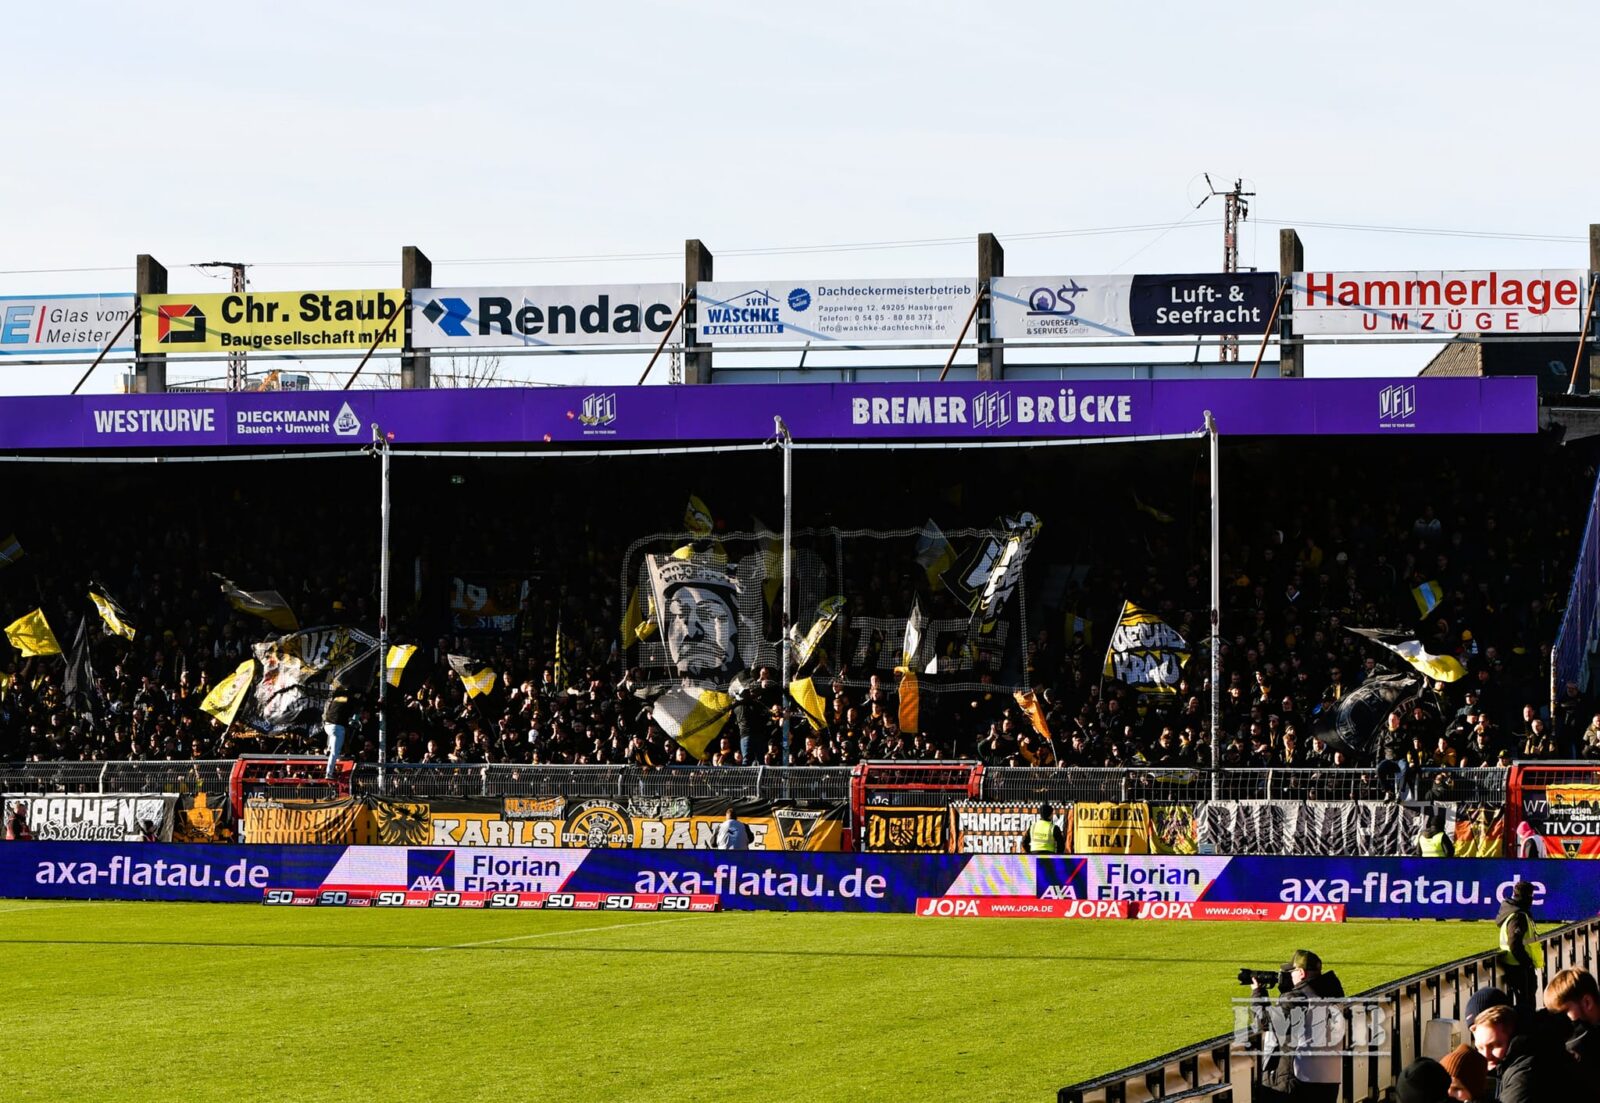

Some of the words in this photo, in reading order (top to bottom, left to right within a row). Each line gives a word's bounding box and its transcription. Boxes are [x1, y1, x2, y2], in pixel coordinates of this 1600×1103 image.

[817, 285, 971, 297] Dachdeckermeisterbetrieb
[1171, 285, 1222, 303] Luft-
[1228, 285, 1244, 302] &
[1306, 271, 1578, 314] Hammerlage
[222, 296, 290, 324] Chr.
[299, 292, 397, 322] Staub
[745, 297, 769, 307] SVEN
[818, 304, 863, 312] Pappelweg
[908, 303, 953, 312] Hasbergen
[50, 308, 89, 323] Glas
[96, 309, 129, 322] vom
[478, 295, 673, 336] Rendac
[707, 307, 780, 323] WASCHKE
[1156, 305, 1261, 324] Seefracht
[1362, 309, 1520, 331] UMZÜGE
[0, 305, 35, 345] E
[708, 325, 779, 335] DACHTECHNIK
[1026, 327, 1032, 335] &
[1040, 319, 1079, 327] OVERSEAS
[46, 328, 112, 344] Meister
[221, 329, 355, 349] Baugesellschaft
[358, 328, 397, 344] mbH
[852, 397, 967, 424] BREMER
[1017, 388, 1132, 423] BRÜCKE
[94, 408, 216, 433] WESTKURVE
[236, 410, 330, 423] DIECKMANN
[236, 423, 273, 434] Bauen
[285, 423, 330, 434] Umwelt
[31, 798, 136, 832] AACHEN
[41, 820, 125, 840] Hooligans
[432, 819, 556, 848] KARLS
[640, 820, 768, 849] BANE
[1543, 822, 1600, 835] TIVOLI
[35, 855, 269, 889] axa-flatau.de
[473, 855, 561, 876] Florian
[634, 864, 887, 898] axa-flatau.de
[1107, 863, 1200, 885] Florian
[409, 875, 445, 892] AXA
[267, 891, 294, 904] SO
[321, 892, 348, 904] SO
[378, 892, 405, 905] SO
[433, 893, 461, 906] SO
[1040, 884, 1077, 900] AXA
[491, 894, 519, 907] SO
[547, 894, 575, 907] SO
[605, 895, 633, 908] SO
[662, 896, 690, 909] SO
[922, 899, 980, 916] JOPA
[991, 905, 1054, 913] WWW.JOPA.DE
[1064, 900, 1121, 918] JOPA
[1137, 902, 1194, 919] JOPA
[1205, 907, 1269, 916] WWW.JOPA.DE
[1279, 904, 1337, 922] JOPA
